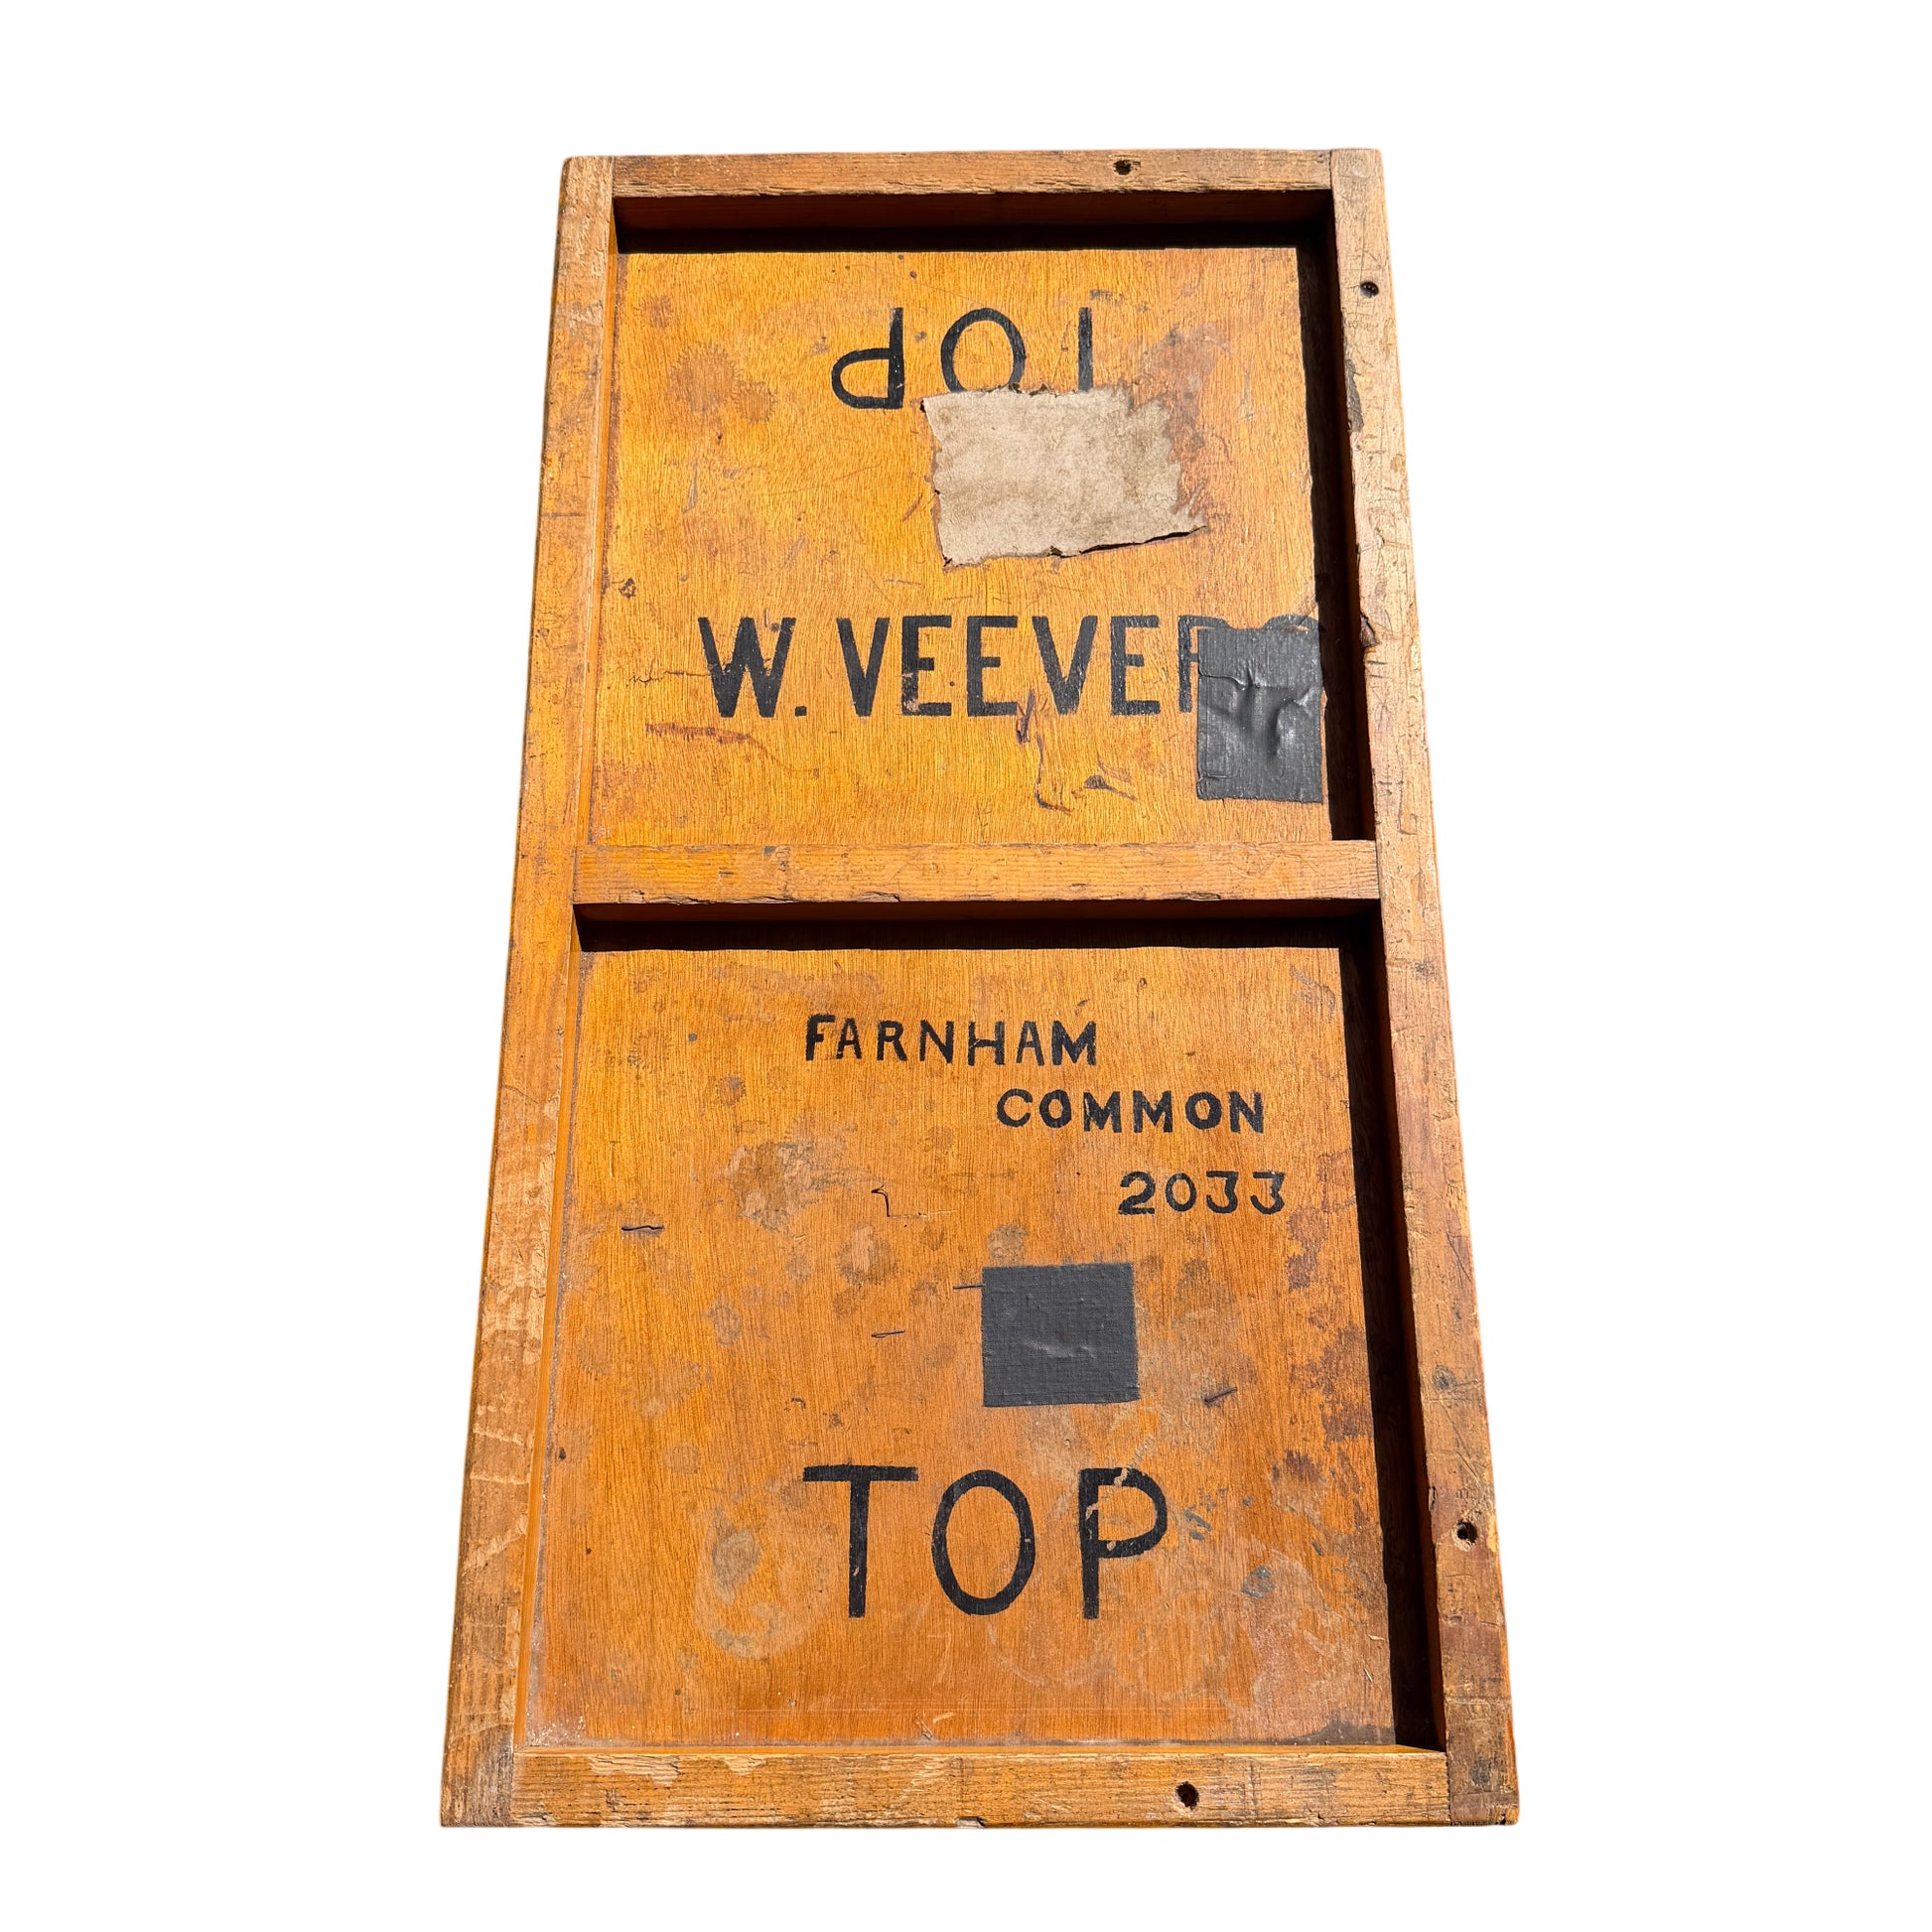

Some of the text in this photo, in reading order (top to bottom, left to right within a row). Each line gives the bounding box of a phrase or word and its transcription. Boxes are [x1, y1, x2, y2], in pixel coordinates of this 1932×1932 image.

[697, 615, 1325, 719] W. VEEVE
[805, 1014, 1097, 1066] FARNHAM
[996, 1088, 1265, 1134] COMMON
[1118, 1170, 1287, 1216] 2033
[802, 1463, 1169, 1620] TOP
